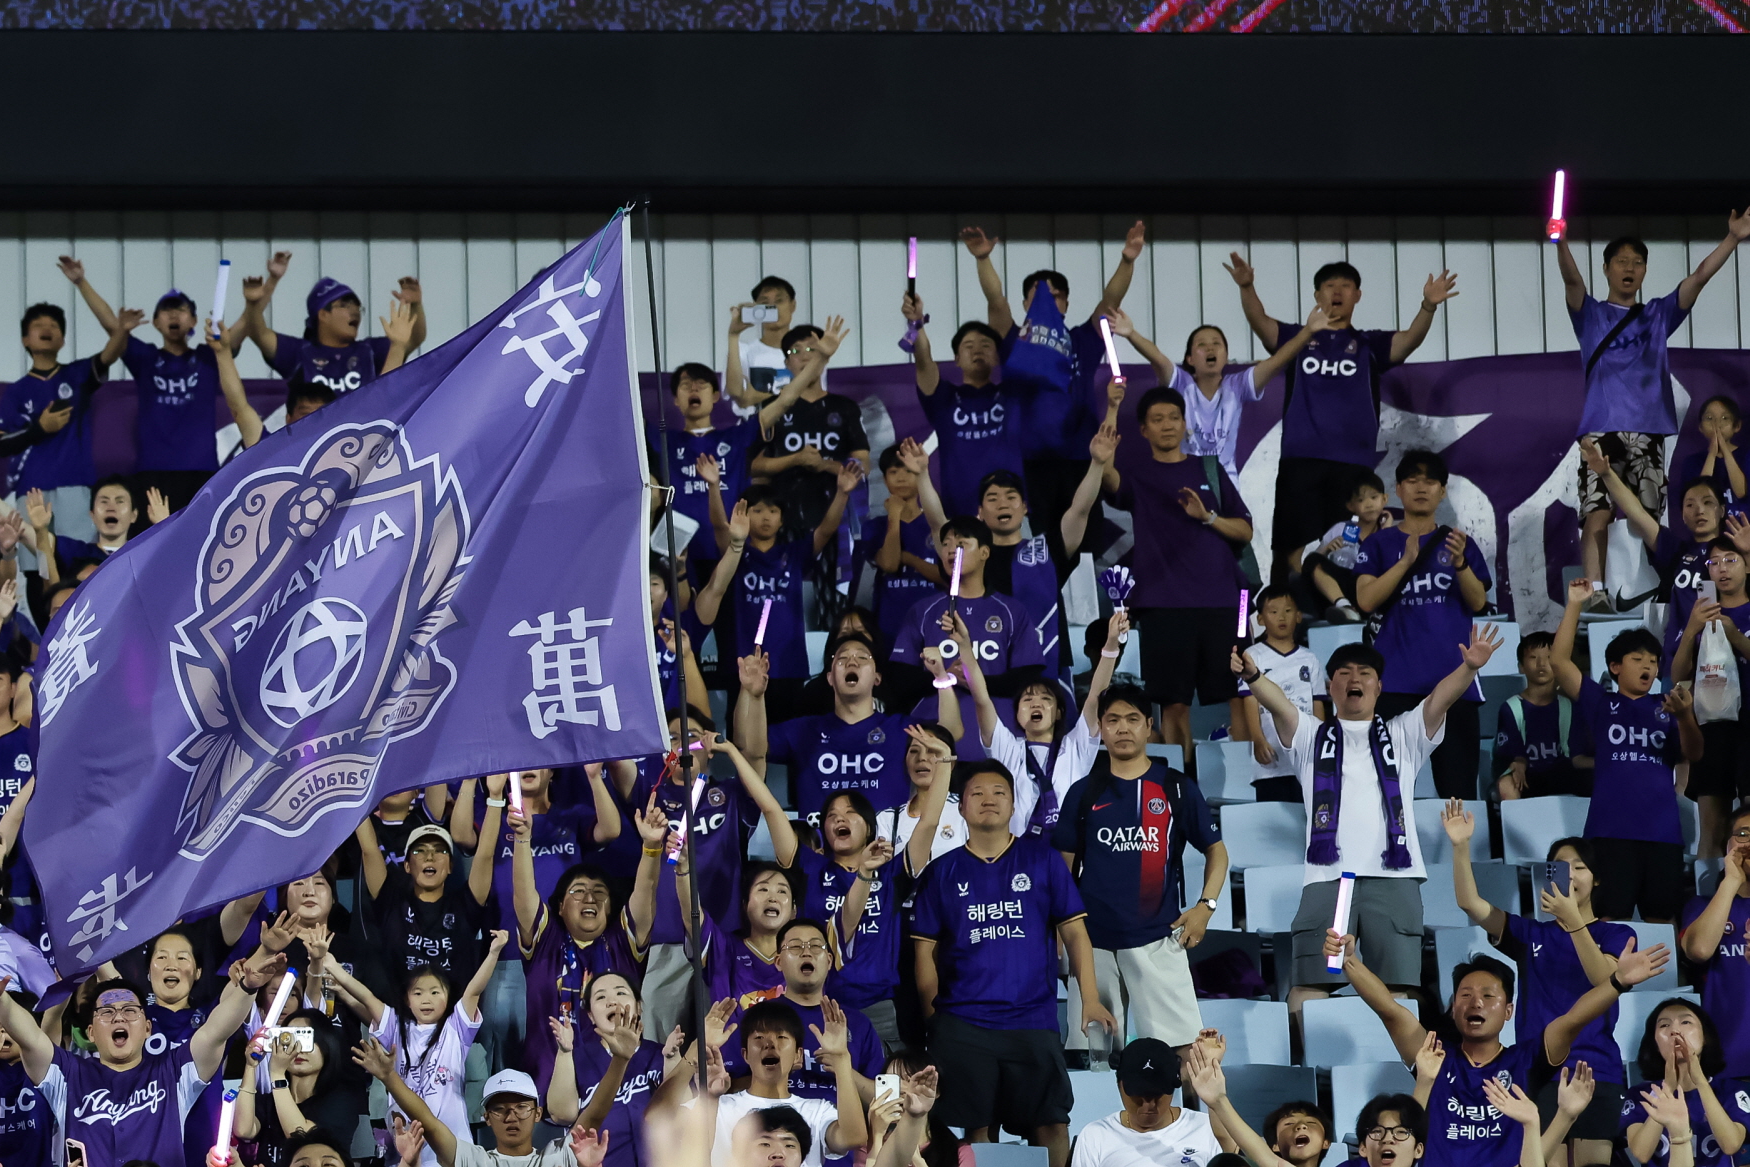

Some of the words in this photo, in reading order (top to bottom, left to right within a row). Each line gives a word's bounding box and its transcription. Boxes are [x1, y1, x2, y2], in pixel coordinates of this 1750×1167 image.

[1302, 358, 1357, 376] OHC
[154, 375, 198, 394] OHC
[953, 405, 1004, 424] OHC
[784, 433, 840, 450] OHC
[1608, 724, 1666, 749] OHC
[817, 753, 884, 774] OHC
[821, 779, 879, 790] 오상헬스케어
[1096, 827, 1159, 845] QATAR
[501, 841, 575, 857] AYANG
[1111, 840, 1159, 853] AIRWAYS
[824, 894, 880, 916] 해턴
[967, 901, 1023, 921] 해링턴
[969, 924, 1025, 943] 플레이스
[74, 1080, 166, 1126] Anyang
[1445, 1122, 1502, 1140] 플레이스
